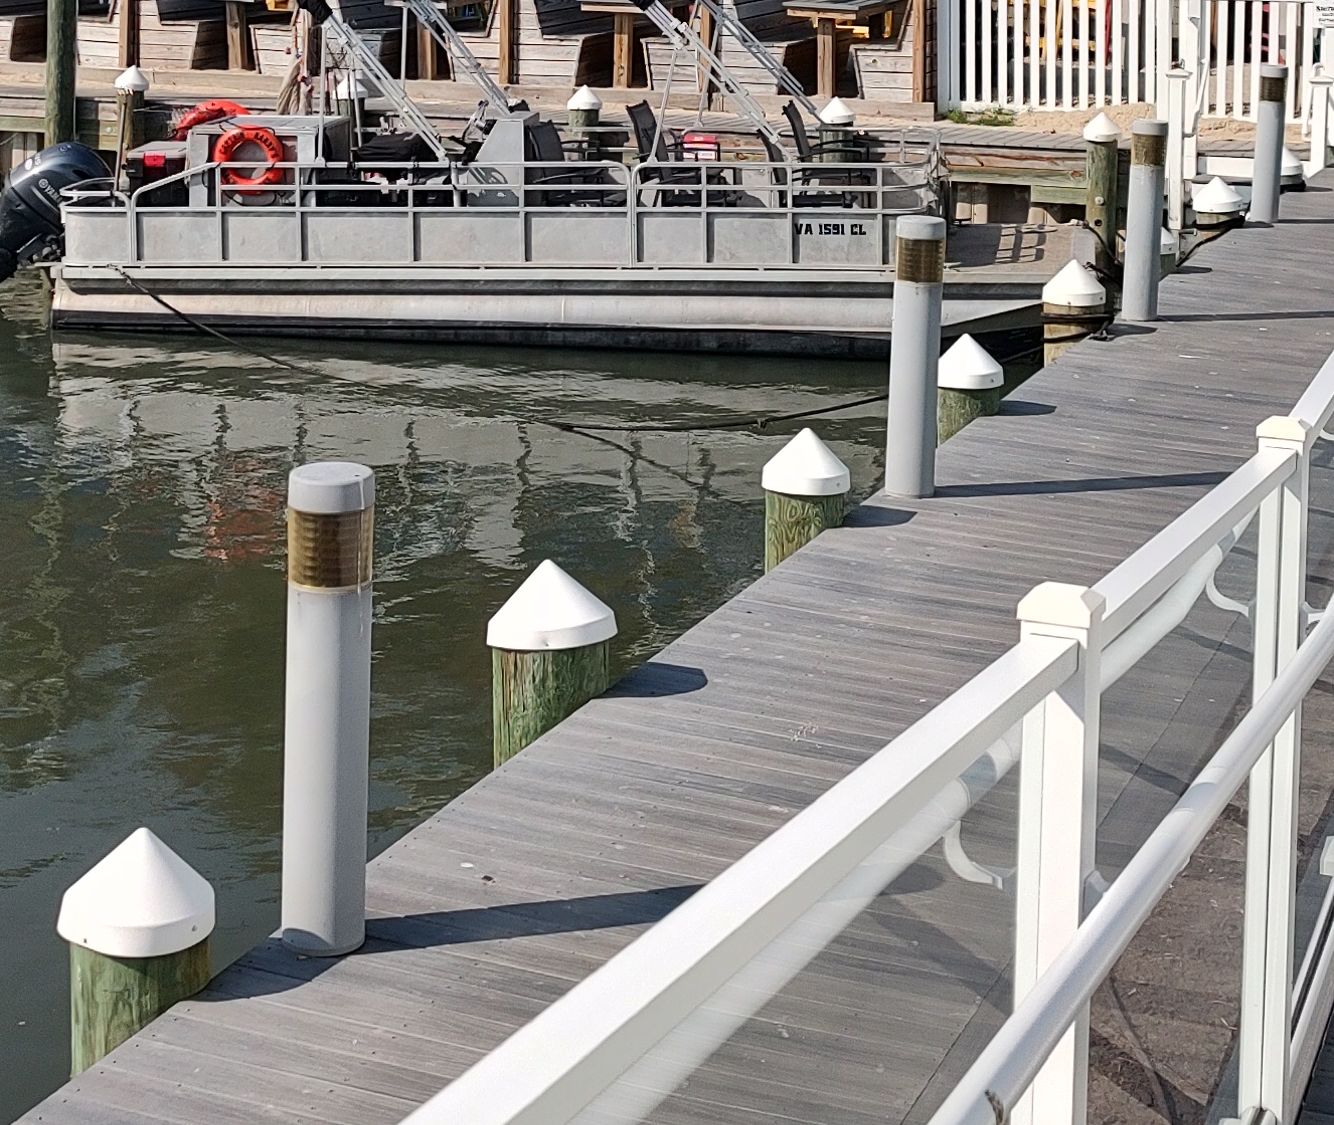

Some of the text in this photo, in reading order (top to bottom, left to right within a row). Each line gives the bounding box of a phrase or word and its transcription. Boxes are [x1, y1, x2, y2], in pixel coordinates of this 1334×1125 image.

[794, 223, 867, 235] VA 1591 CL
